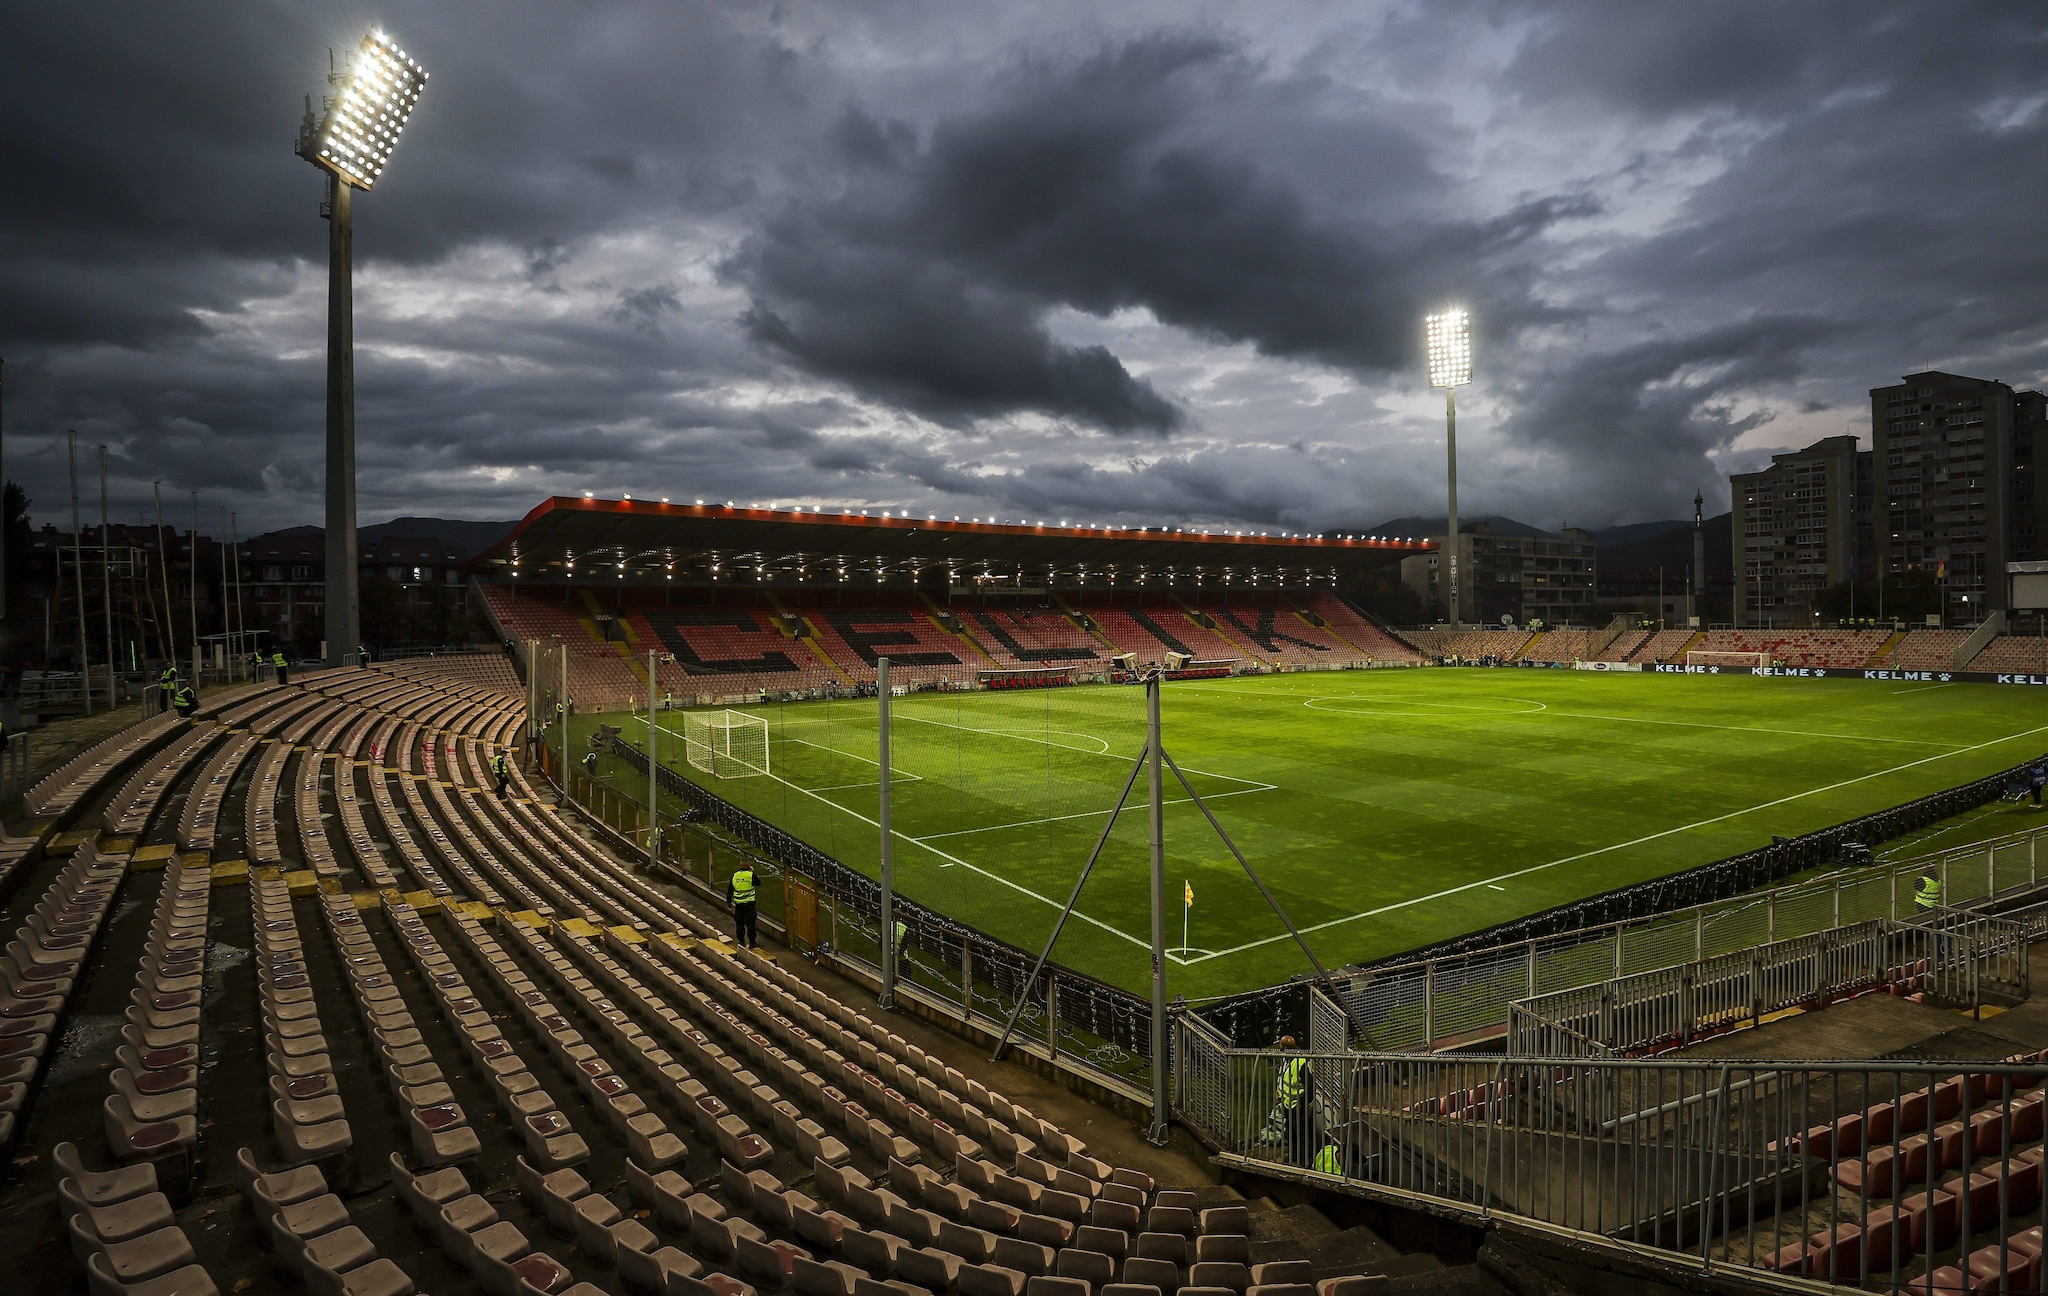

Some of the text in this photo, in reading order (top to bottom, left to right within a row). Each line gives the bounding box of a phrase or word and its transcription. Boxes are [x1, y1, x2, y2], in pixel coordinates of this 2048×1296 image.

[1656, 665, 1705, 673] KELME
[1752, 667, 1809, 676] KELME
[1864, 670, 1932, 681] KELME
[1998, 674, 2048, 685] KEL
